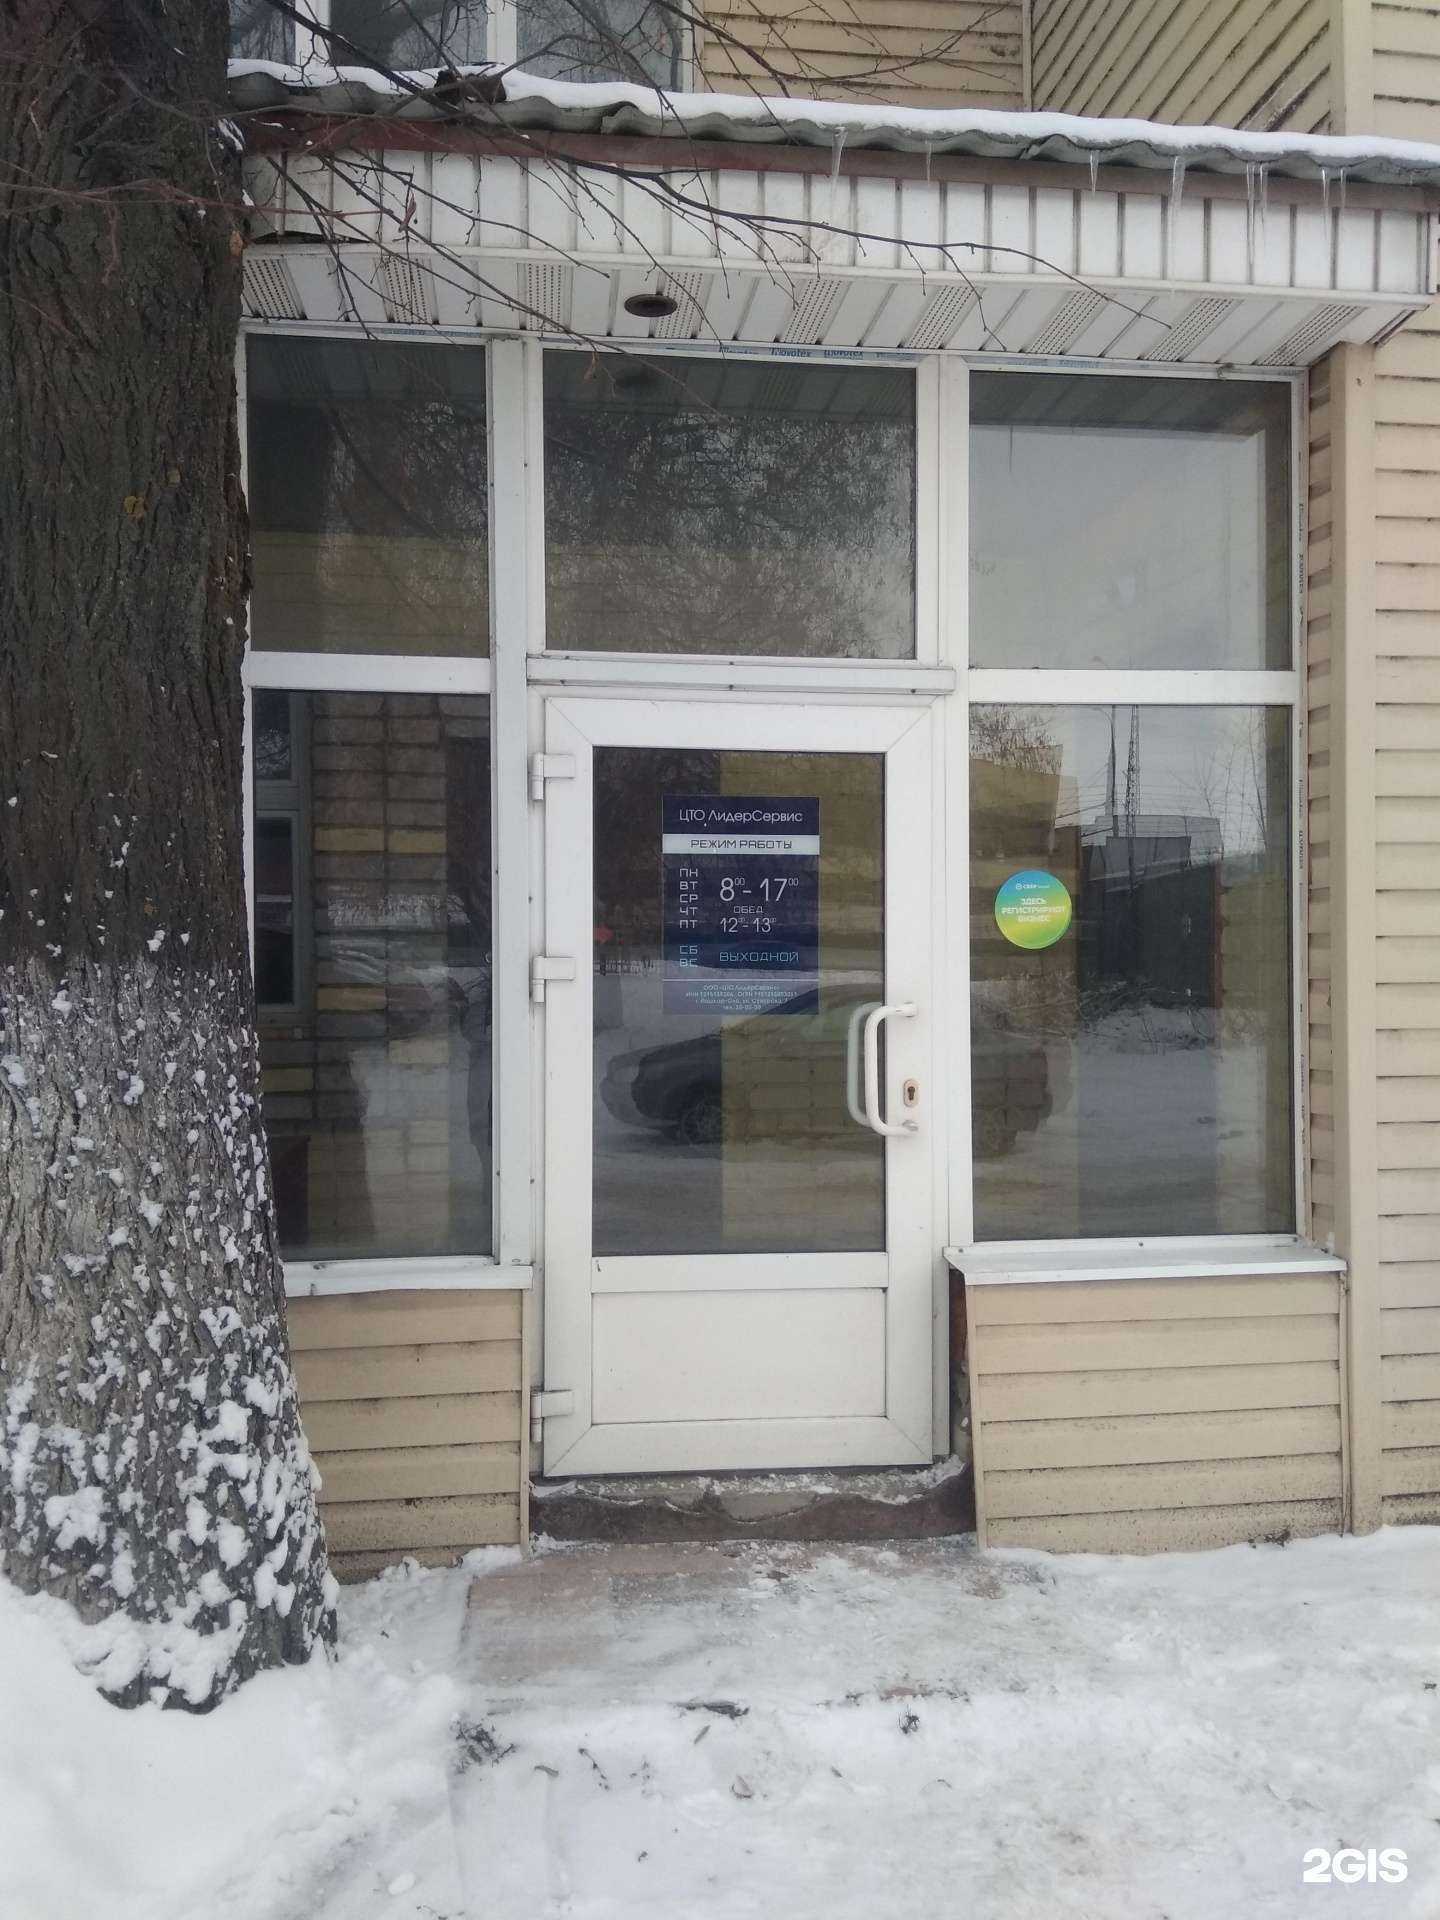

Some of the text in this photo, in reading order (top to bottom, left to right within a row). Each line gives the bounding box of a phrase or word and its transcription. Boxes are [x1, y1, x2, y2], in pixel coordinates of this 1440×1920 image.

[679, 809, 803, 823] ЦТО ЛидерСервис
[690, 840, 792, 849] РЕЖИМ РАБОТЫ
[679, 868, 698, 877] ПН
[679, 881, 698, 890] ВТ
[679, 894, 698, 903] СР
[679, 907, 698, 915] ЧТ
[733, 906, 763, 914] ОБЕД
[679, 920, 698, 929] ПТ
[679, 946, 698, 955] СБ
[720, 951, 799, 962] ВЫХОДНОЙ
[679, 958, 698, 967] ВС
